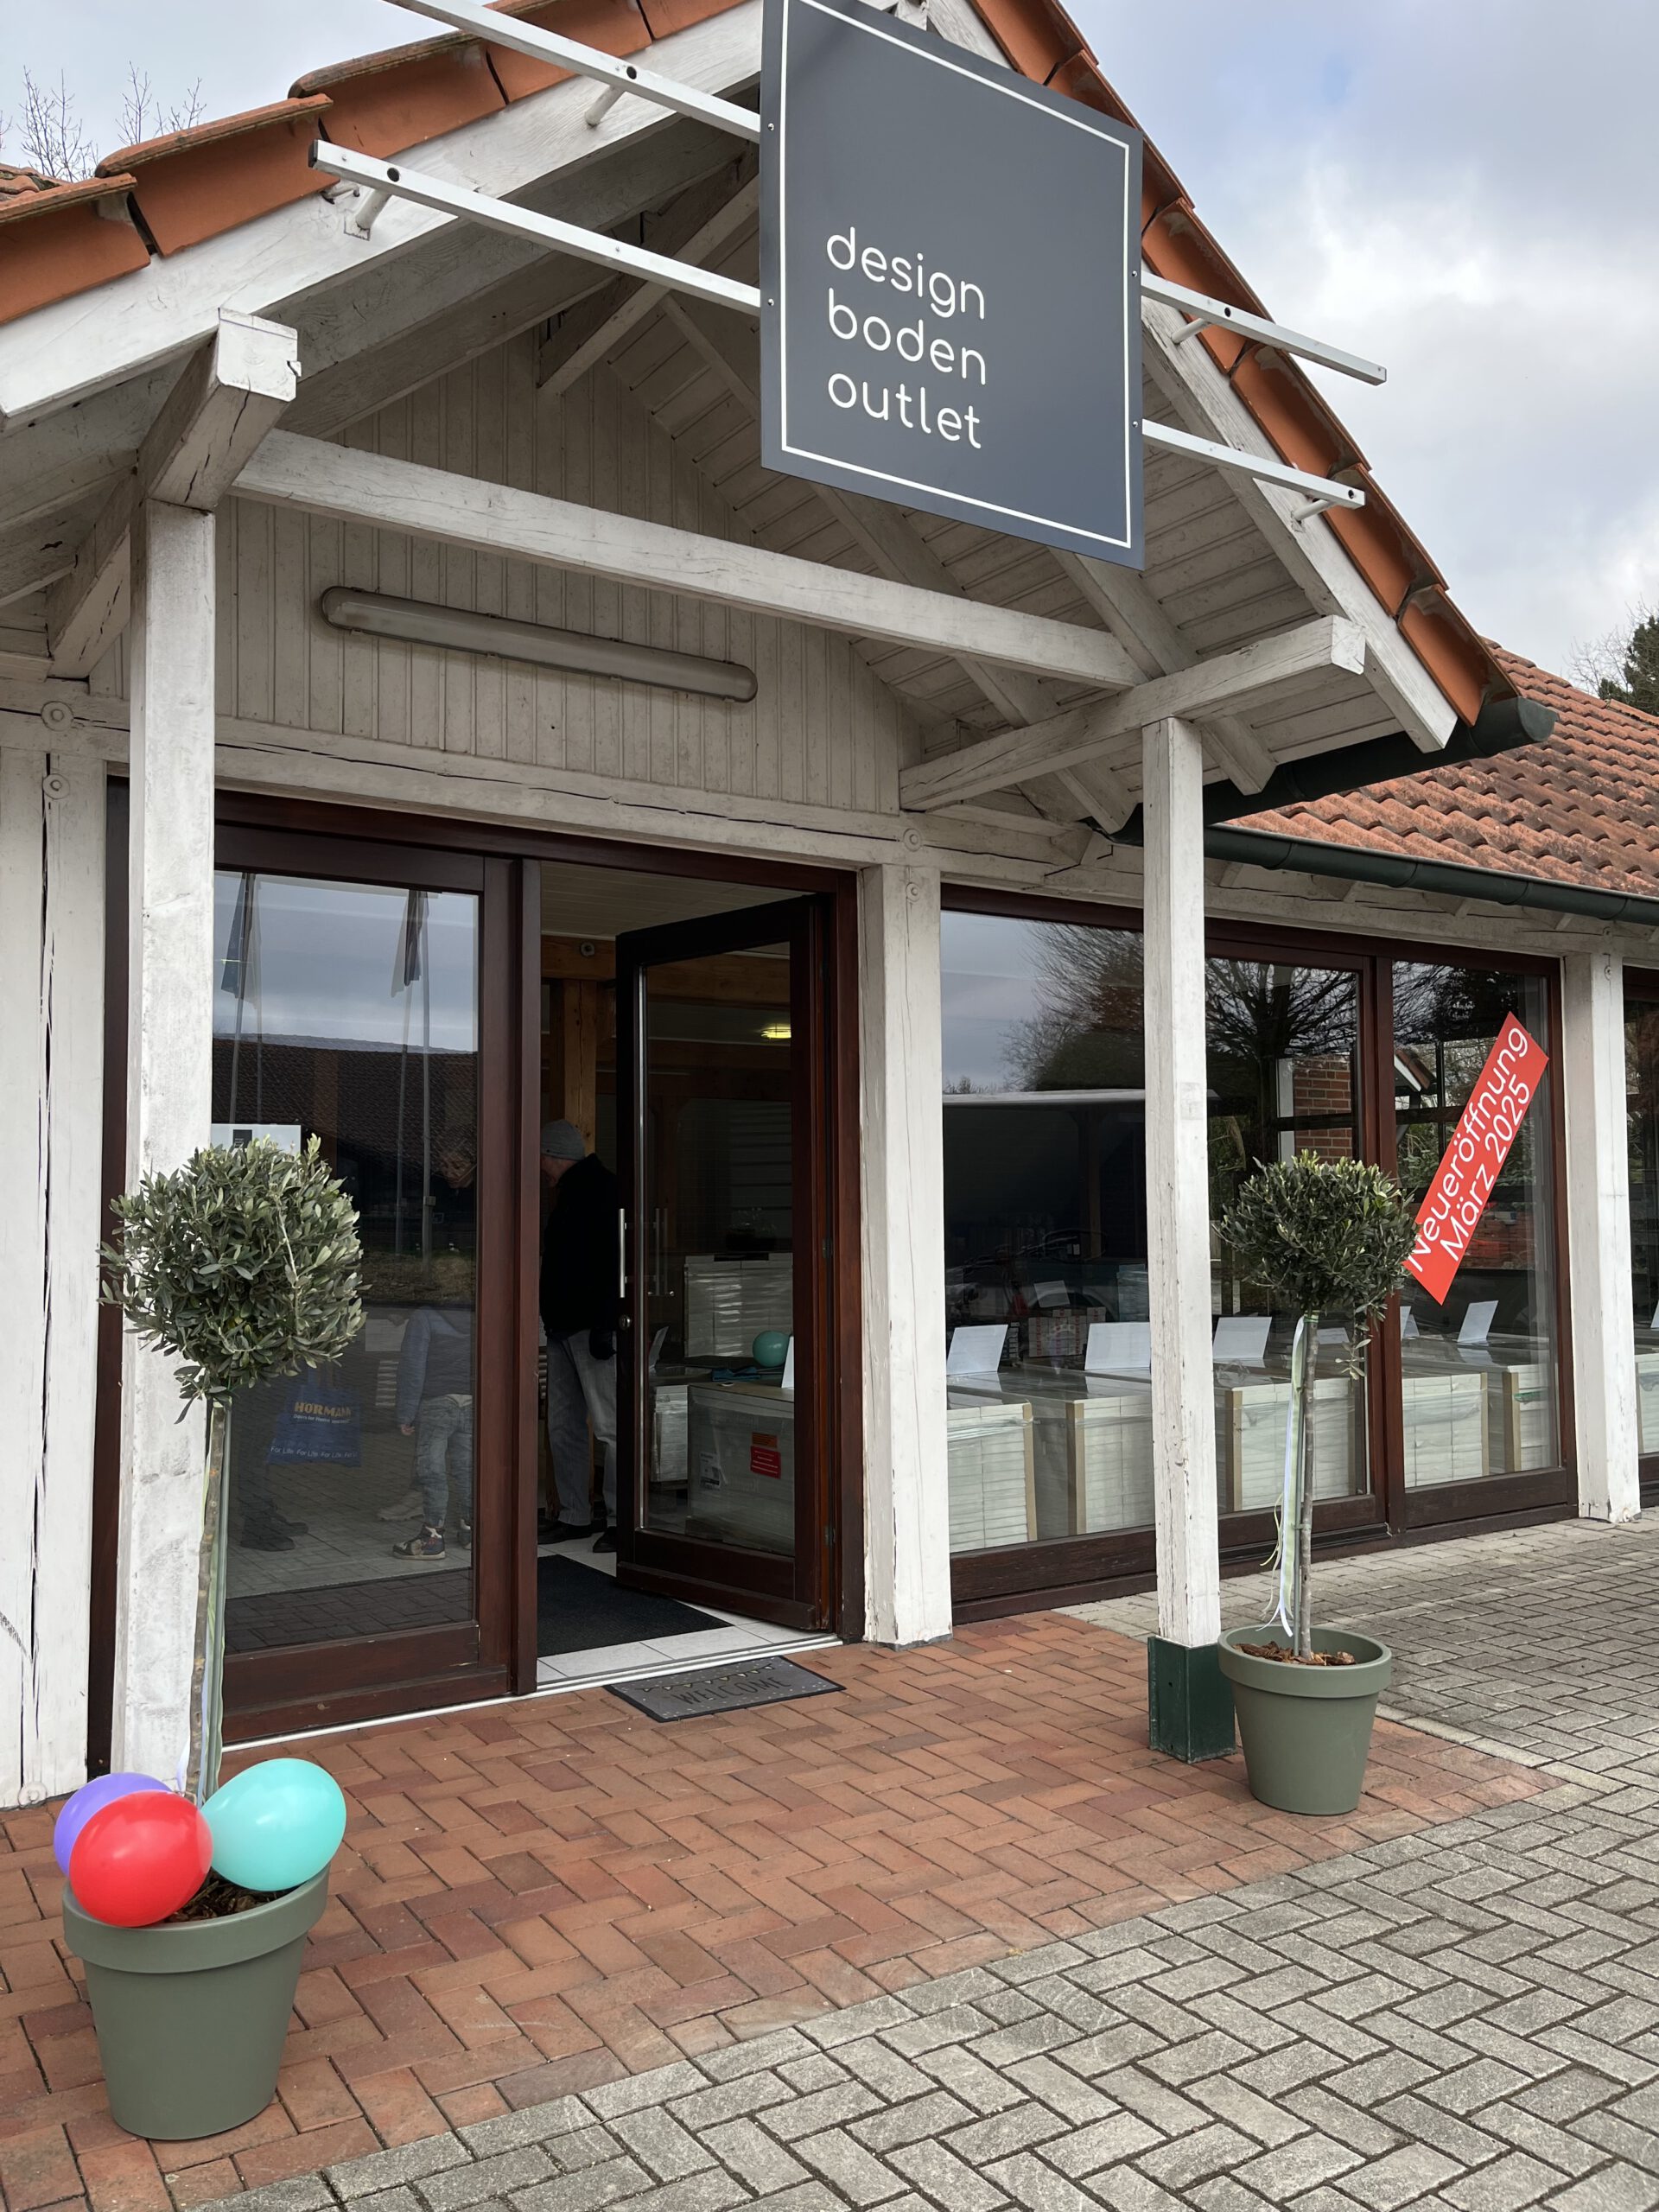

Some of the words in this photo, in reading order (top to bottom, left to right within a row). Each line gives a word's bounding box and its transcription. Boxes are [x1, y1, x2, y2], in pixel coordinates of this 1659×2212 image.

[826, 226, 985, 320] design
[828, 288, 986, 385] boden
[827, 372, 982, 449] outlet
[1407, 1027, 1530, 1273] Neueröffnung
[1439, 1162, 1495, 1262] März
[1484, 1073, 1530, 1164] 2025
[670, 1677, 791, 1705] WELCOME
